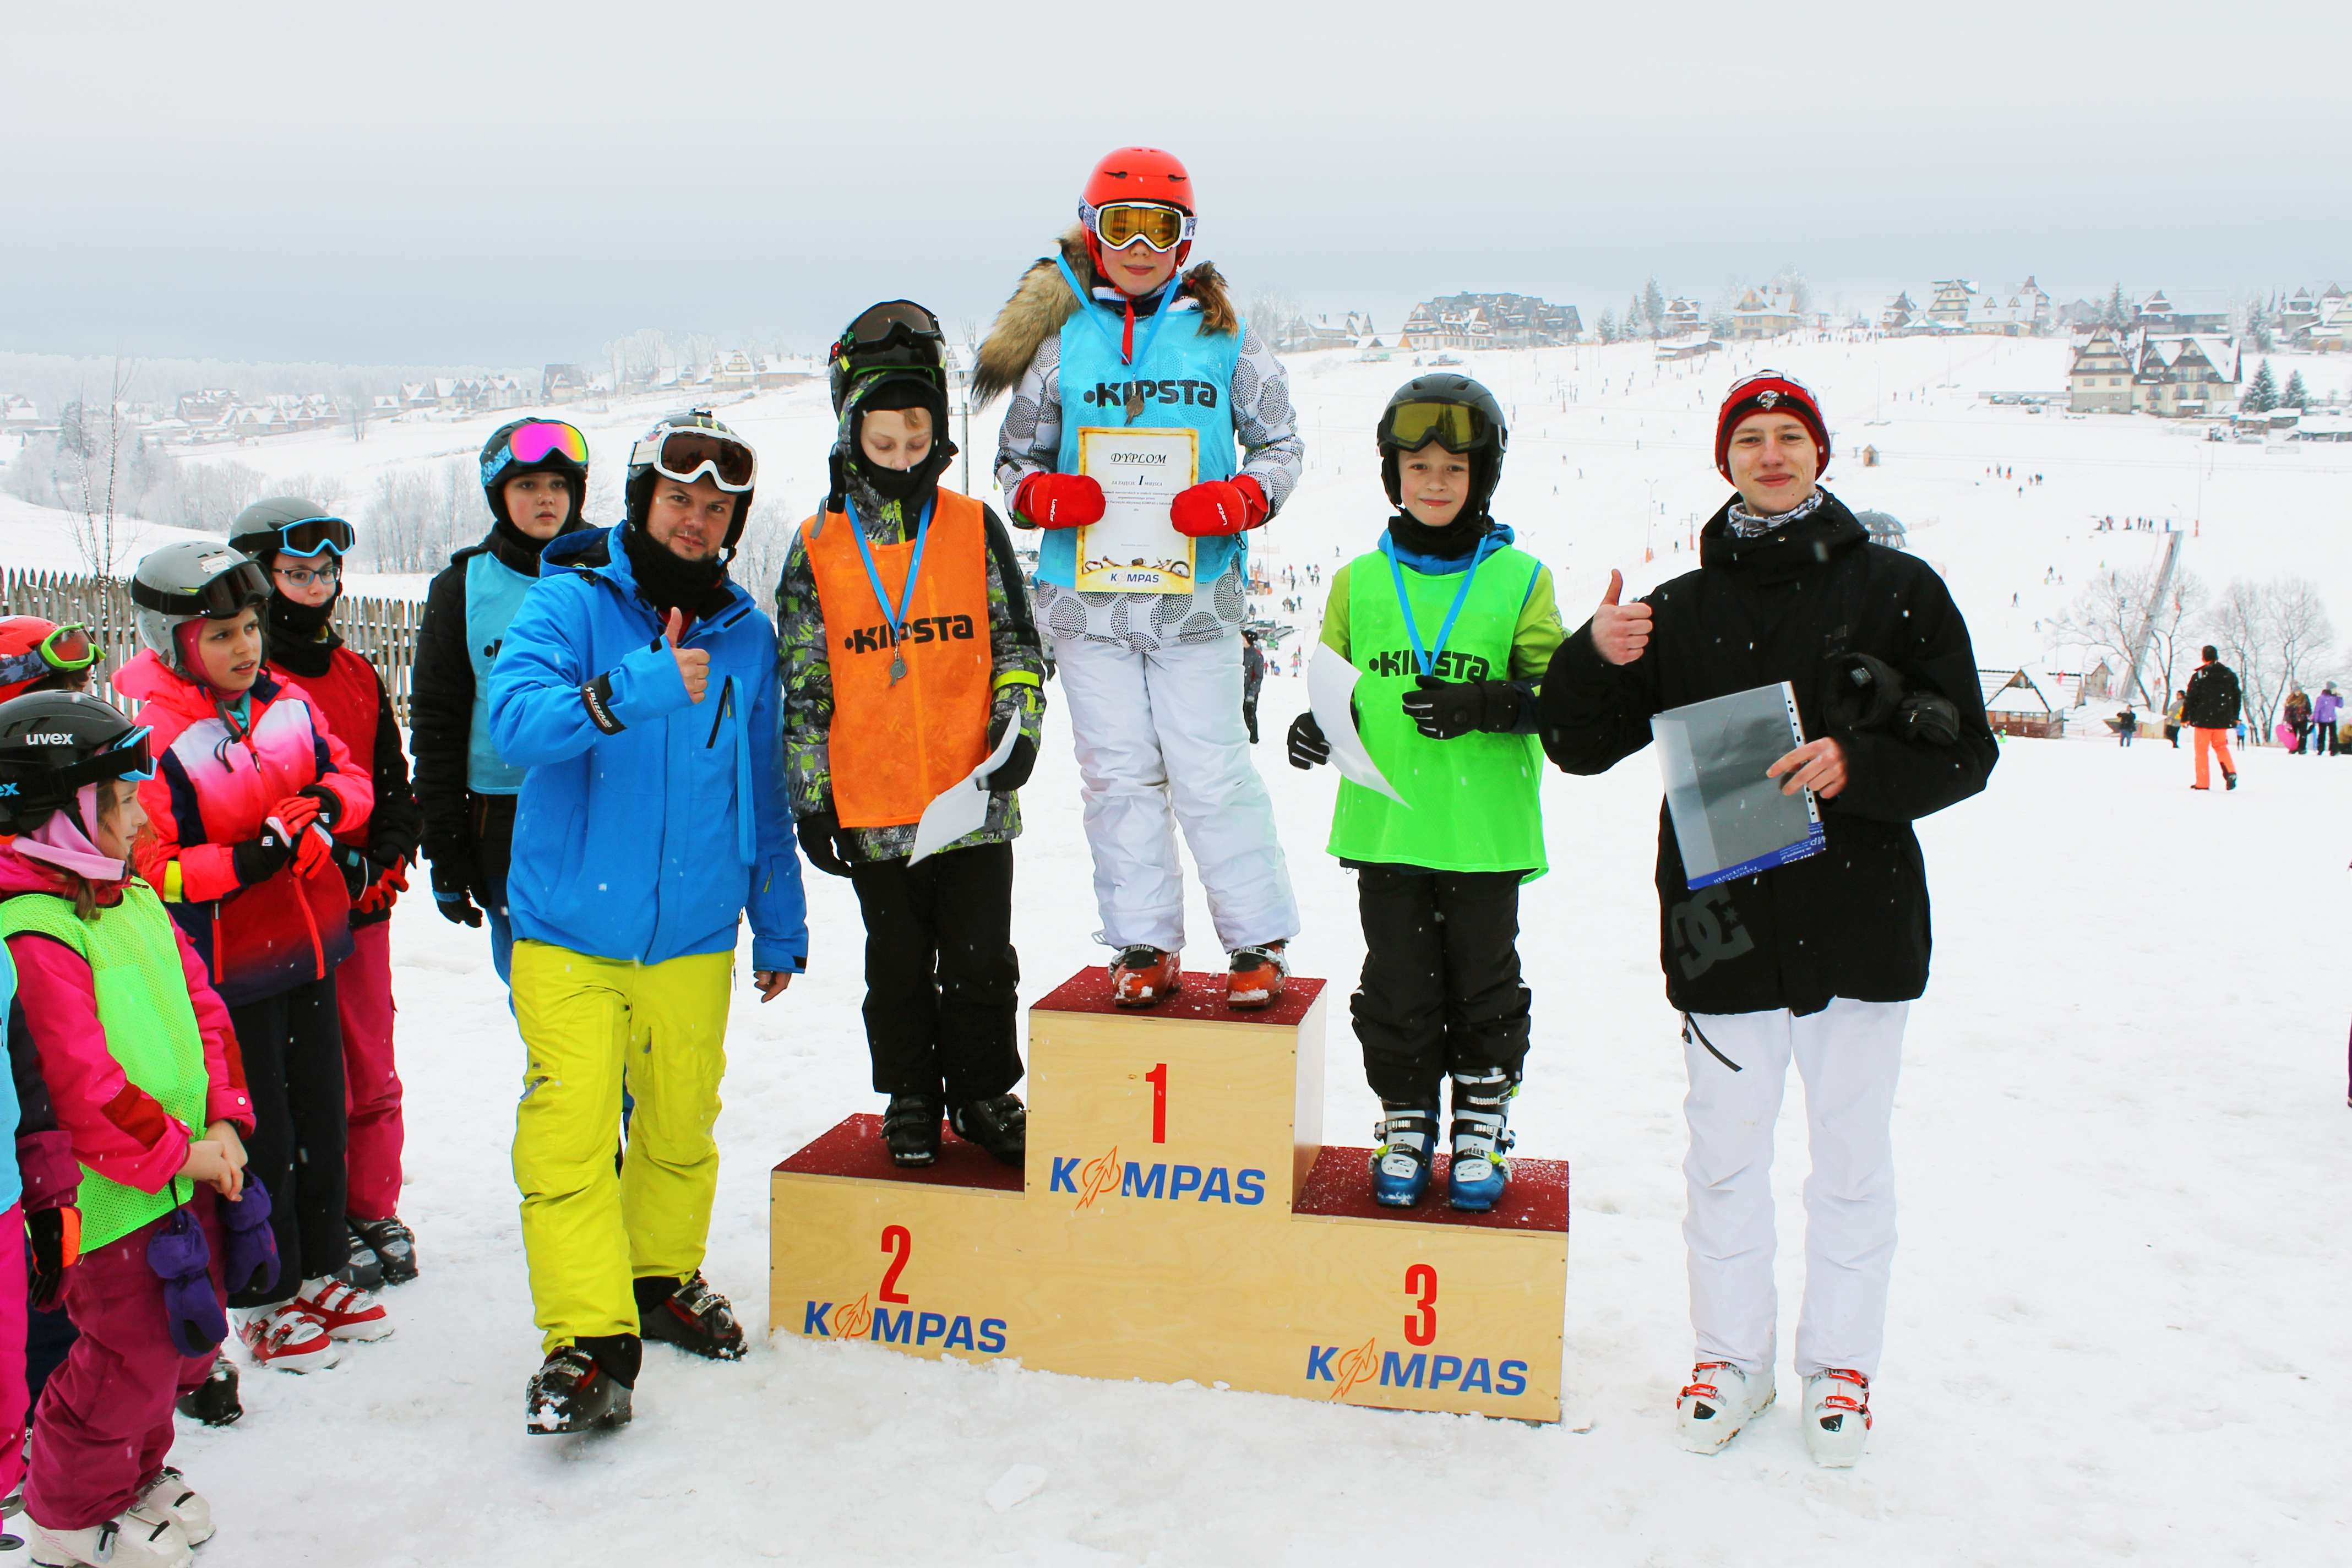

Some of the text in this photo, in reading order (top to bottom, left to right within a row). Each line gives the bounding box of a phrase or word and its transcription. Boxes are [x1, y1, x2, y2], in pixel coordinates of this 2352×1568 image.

[1110, 453, 1167, 464] DYPLOM
[1139, 475, 1144, 486] I
[590, 692, 613, 727] BLIZZARD
[26, 733, 74, 745] uvex
[1146, 1063, 1167, 1144] 1
[1050, 1157, 1266, 1206] KOMPAS
[879, 1224, 911, 1305] 2
[804, 1300, 1006, 1353] KOMPAS
[1404, 1264, 1437, 1347] 3
[1306, 1345, 1528, 1396] KOMPAS
